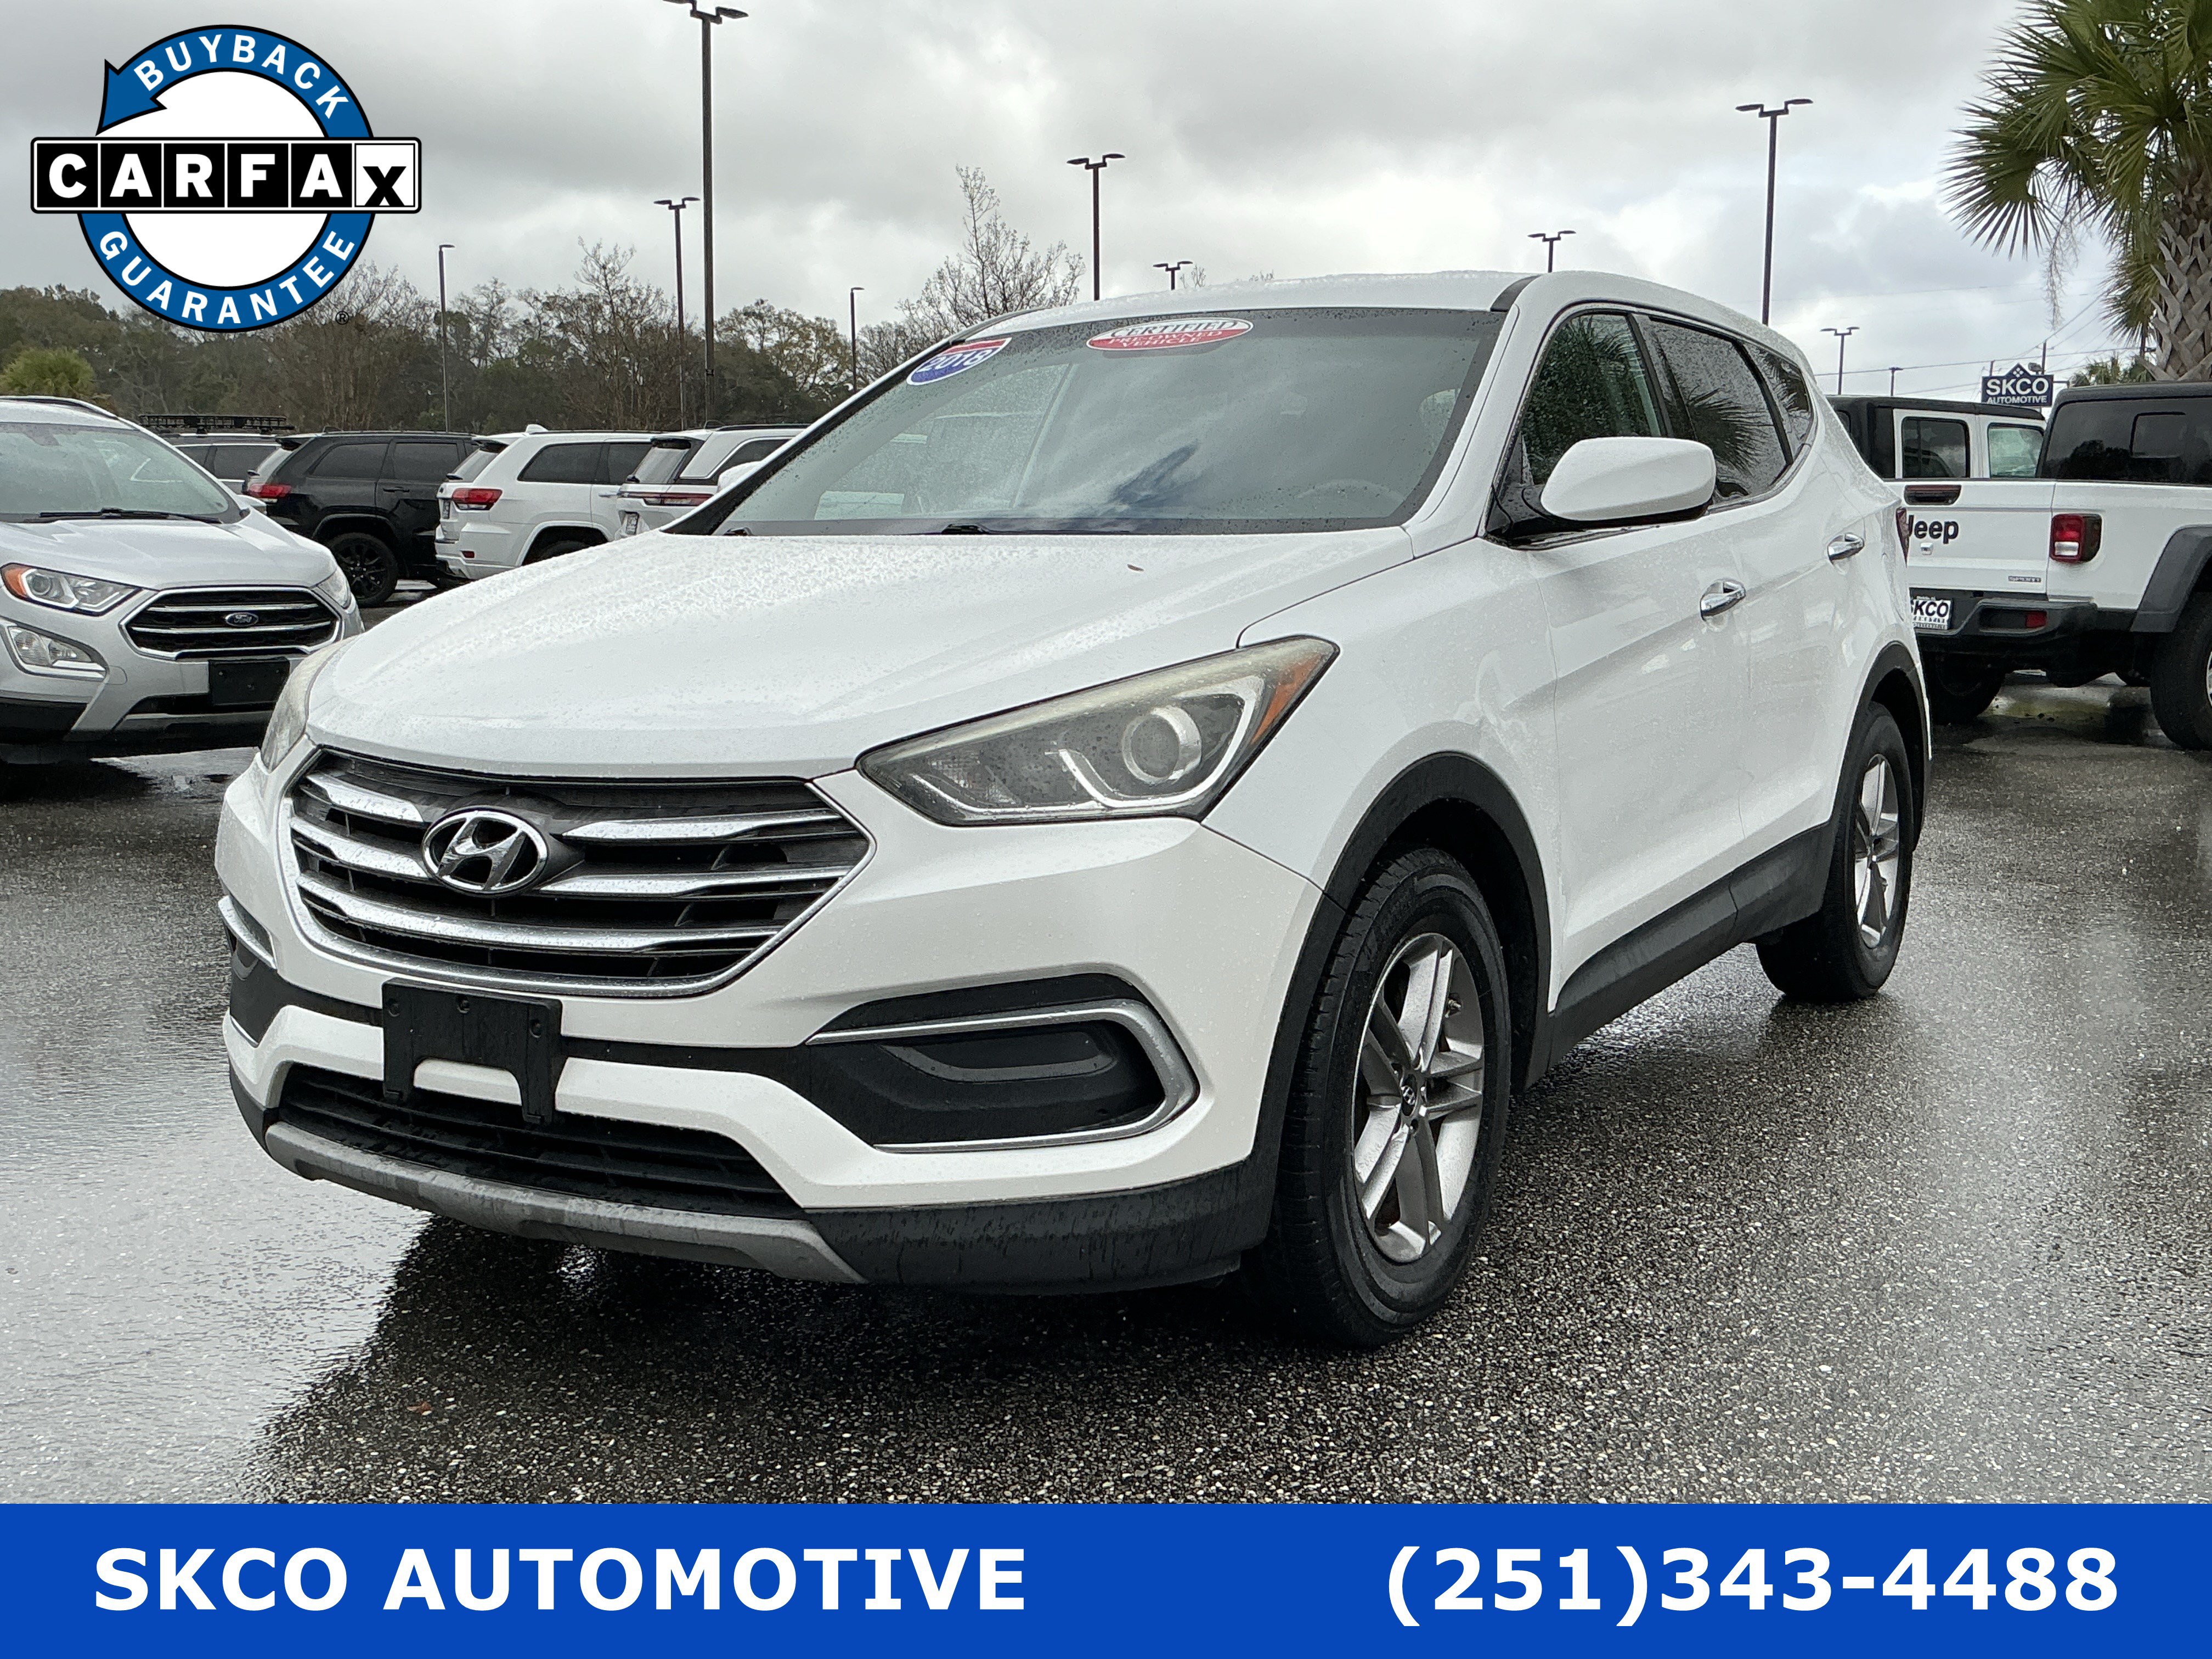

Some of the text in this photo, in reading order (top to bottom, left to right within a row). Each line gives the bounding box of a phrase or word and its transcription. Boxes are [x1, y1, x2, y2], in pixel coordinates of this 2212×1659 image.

[1110, 320, 1238, 337] CERTIFIED
[1122, 336, 1203, 347] VEHICLE
[916, 349, 993, 373] 2018
[1985, 377, 2049, 396] SKCO
[1987, 395, 2047, 404] AUTOMOTIVE
[1908, 514, 1959, 544] Jeep
